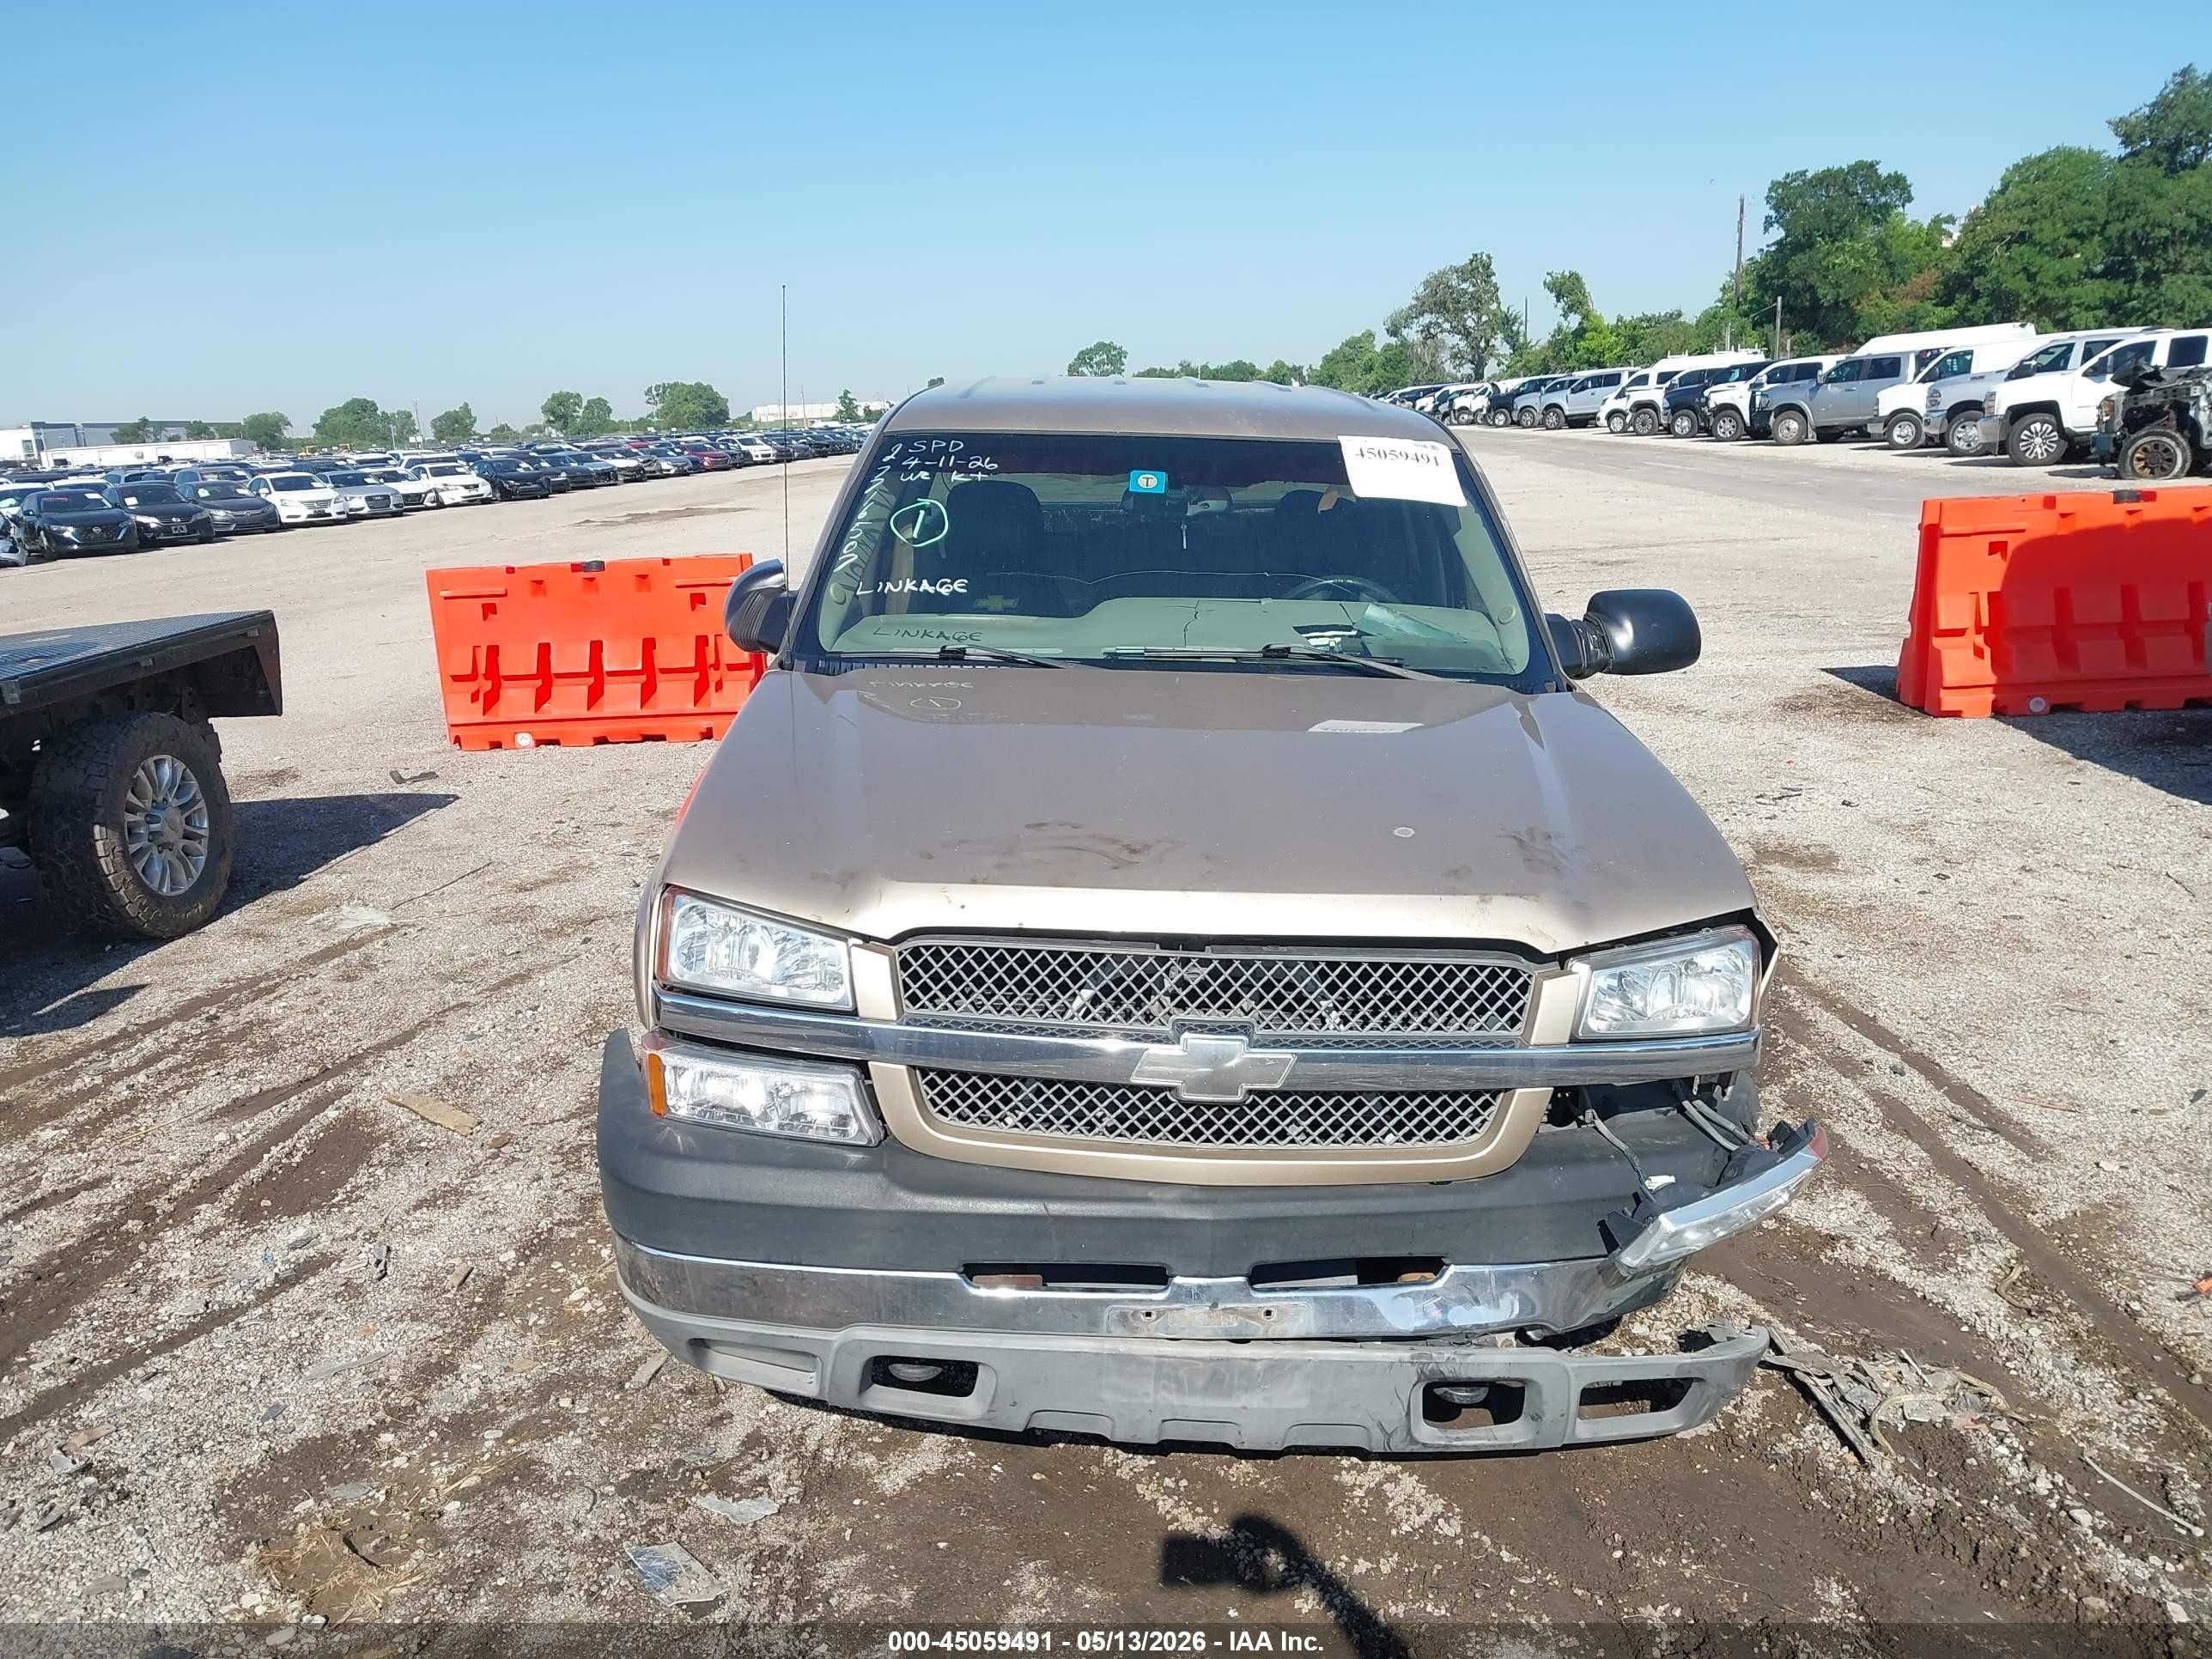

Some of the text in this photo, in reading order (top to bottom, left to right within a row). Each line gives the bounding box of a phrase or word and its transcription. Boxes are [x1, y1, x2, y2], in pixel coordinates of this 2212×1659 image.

[908, 440, 964, 453] SPD
[901, 455, 999, 471] 4-11-26
[1354, 447, 1440, 467] 45059491
[856, 578, 969, 596] LINKAGE
